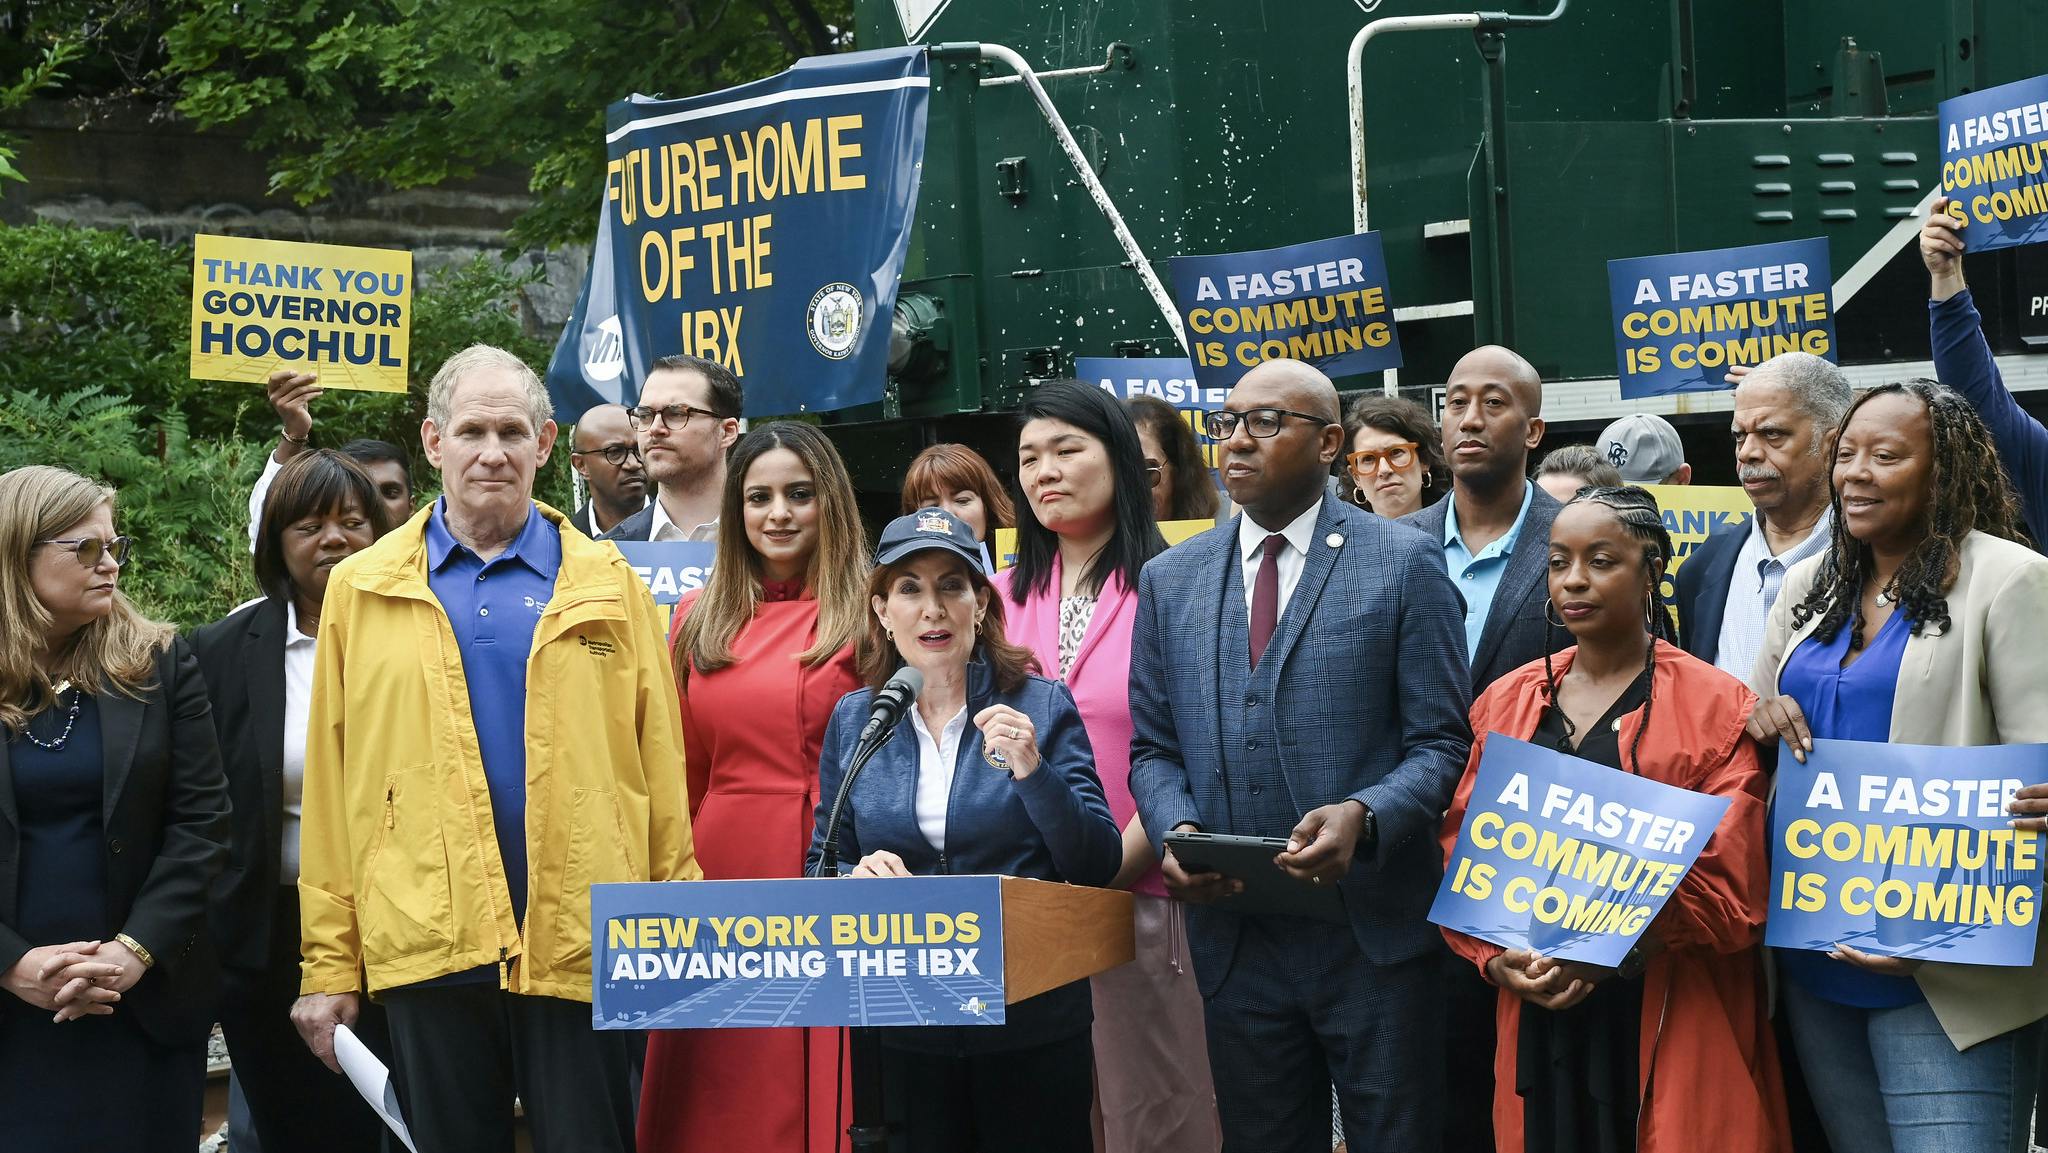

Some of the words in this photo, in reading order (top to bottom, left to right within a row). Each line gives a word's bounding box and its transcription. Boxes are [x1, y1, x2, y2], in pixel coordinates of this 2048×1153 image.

[1947, 124, 1961, 153] A
[607, 137, 723, 226] FUTURE
[723, 114, 866, 205] HOME
[203, 258, 323, 291] THANK
[333, 268, 403, 297] YOU
[640, 227, 695, 303] OF
[702, 213, 773, 295] THE
[1197, 276, 1221, 301] A
[1227, 257, 1364, 299] FASTER
[1634, 278, 1661, 305] A
[1669, 262, 1809, 301] FASTER
[202, 290, 401, 328] GOVERNOR
[1188, 287, 1386, 334] COMMUTE
[1622, 293, 1827, 339] COMMUTE
[201, 321, 401, 367] HOCHUL
[681, 305, 744, 377] IBX
[1195, 342, 1229, 367] IS
[1235, 322, 1391, 366] COMING
[1626, 346, 1661, 375] IS
[1670, 329, 1830, 369] COMING
[1100, 378, 1118, 400] A
[1126, 378, 1234, 403] FASTE
[1661, 510, 1730, 534] ANK
[1496, 772, 1529, 811] A
[1540, 783, 1695, 855] FASTER
[1805, 772, 1844, 810] A
[1858, 774, 2025, 817] FASTER
[1470, 811, 1685, 897] COMMUTE
[1785, 818, 2038, 870] COMMUTE
[1450, 857, 1498, 900] IS
[1503, 876, 1651, 936] COMING
[1781, 871, 1829, 912] IS
[1839, 876, 2034, 926] COMING
[608, 917, 700, 949] NEW
[708, 915, 821, 947] YORK
[831, 912, 982, 946] BUILDS
[611, 949, 827, 981] ADVANCING
[837, 948, 907, 978] THE
[918, 948, 981, 976] IBX
